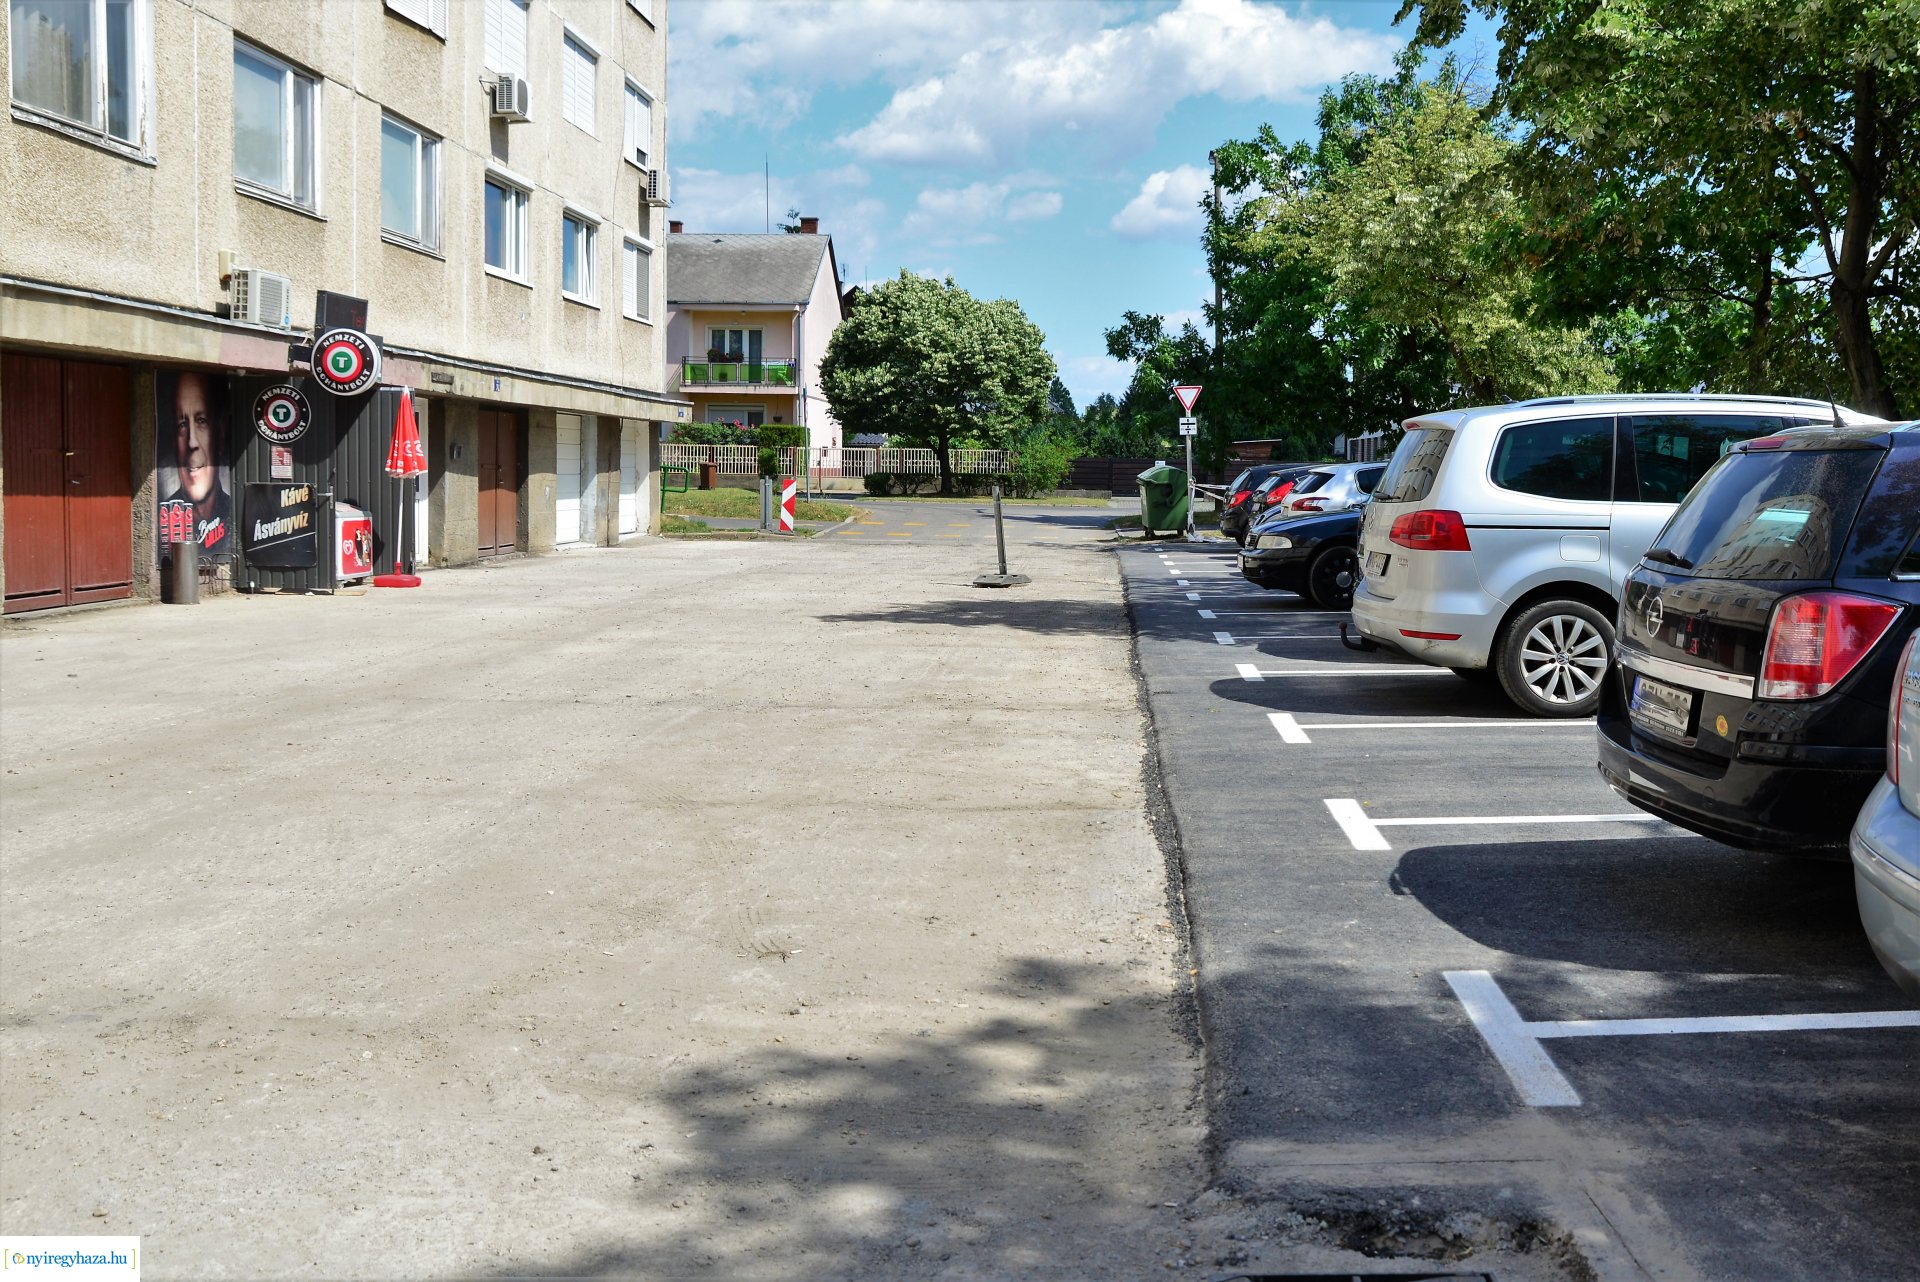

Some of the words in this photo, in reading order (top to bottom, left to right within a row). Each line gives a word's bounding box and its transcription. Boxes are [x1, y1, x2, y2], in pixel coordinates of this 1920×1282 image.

[322, 334, 365, 349] NEMZETI
[336, 357, 348, 368] T
[316, 368, 371, 391] DOHÁNYBOLT
[262, 387, 300, 401] NEMZETI
[276, 408, 287, 420] T
[258, 420, 306, 440] DOHÁNYBOLT
[281, 484, 309, 508] Kávé
[253, 511, 309, 541] Ásványvíz
